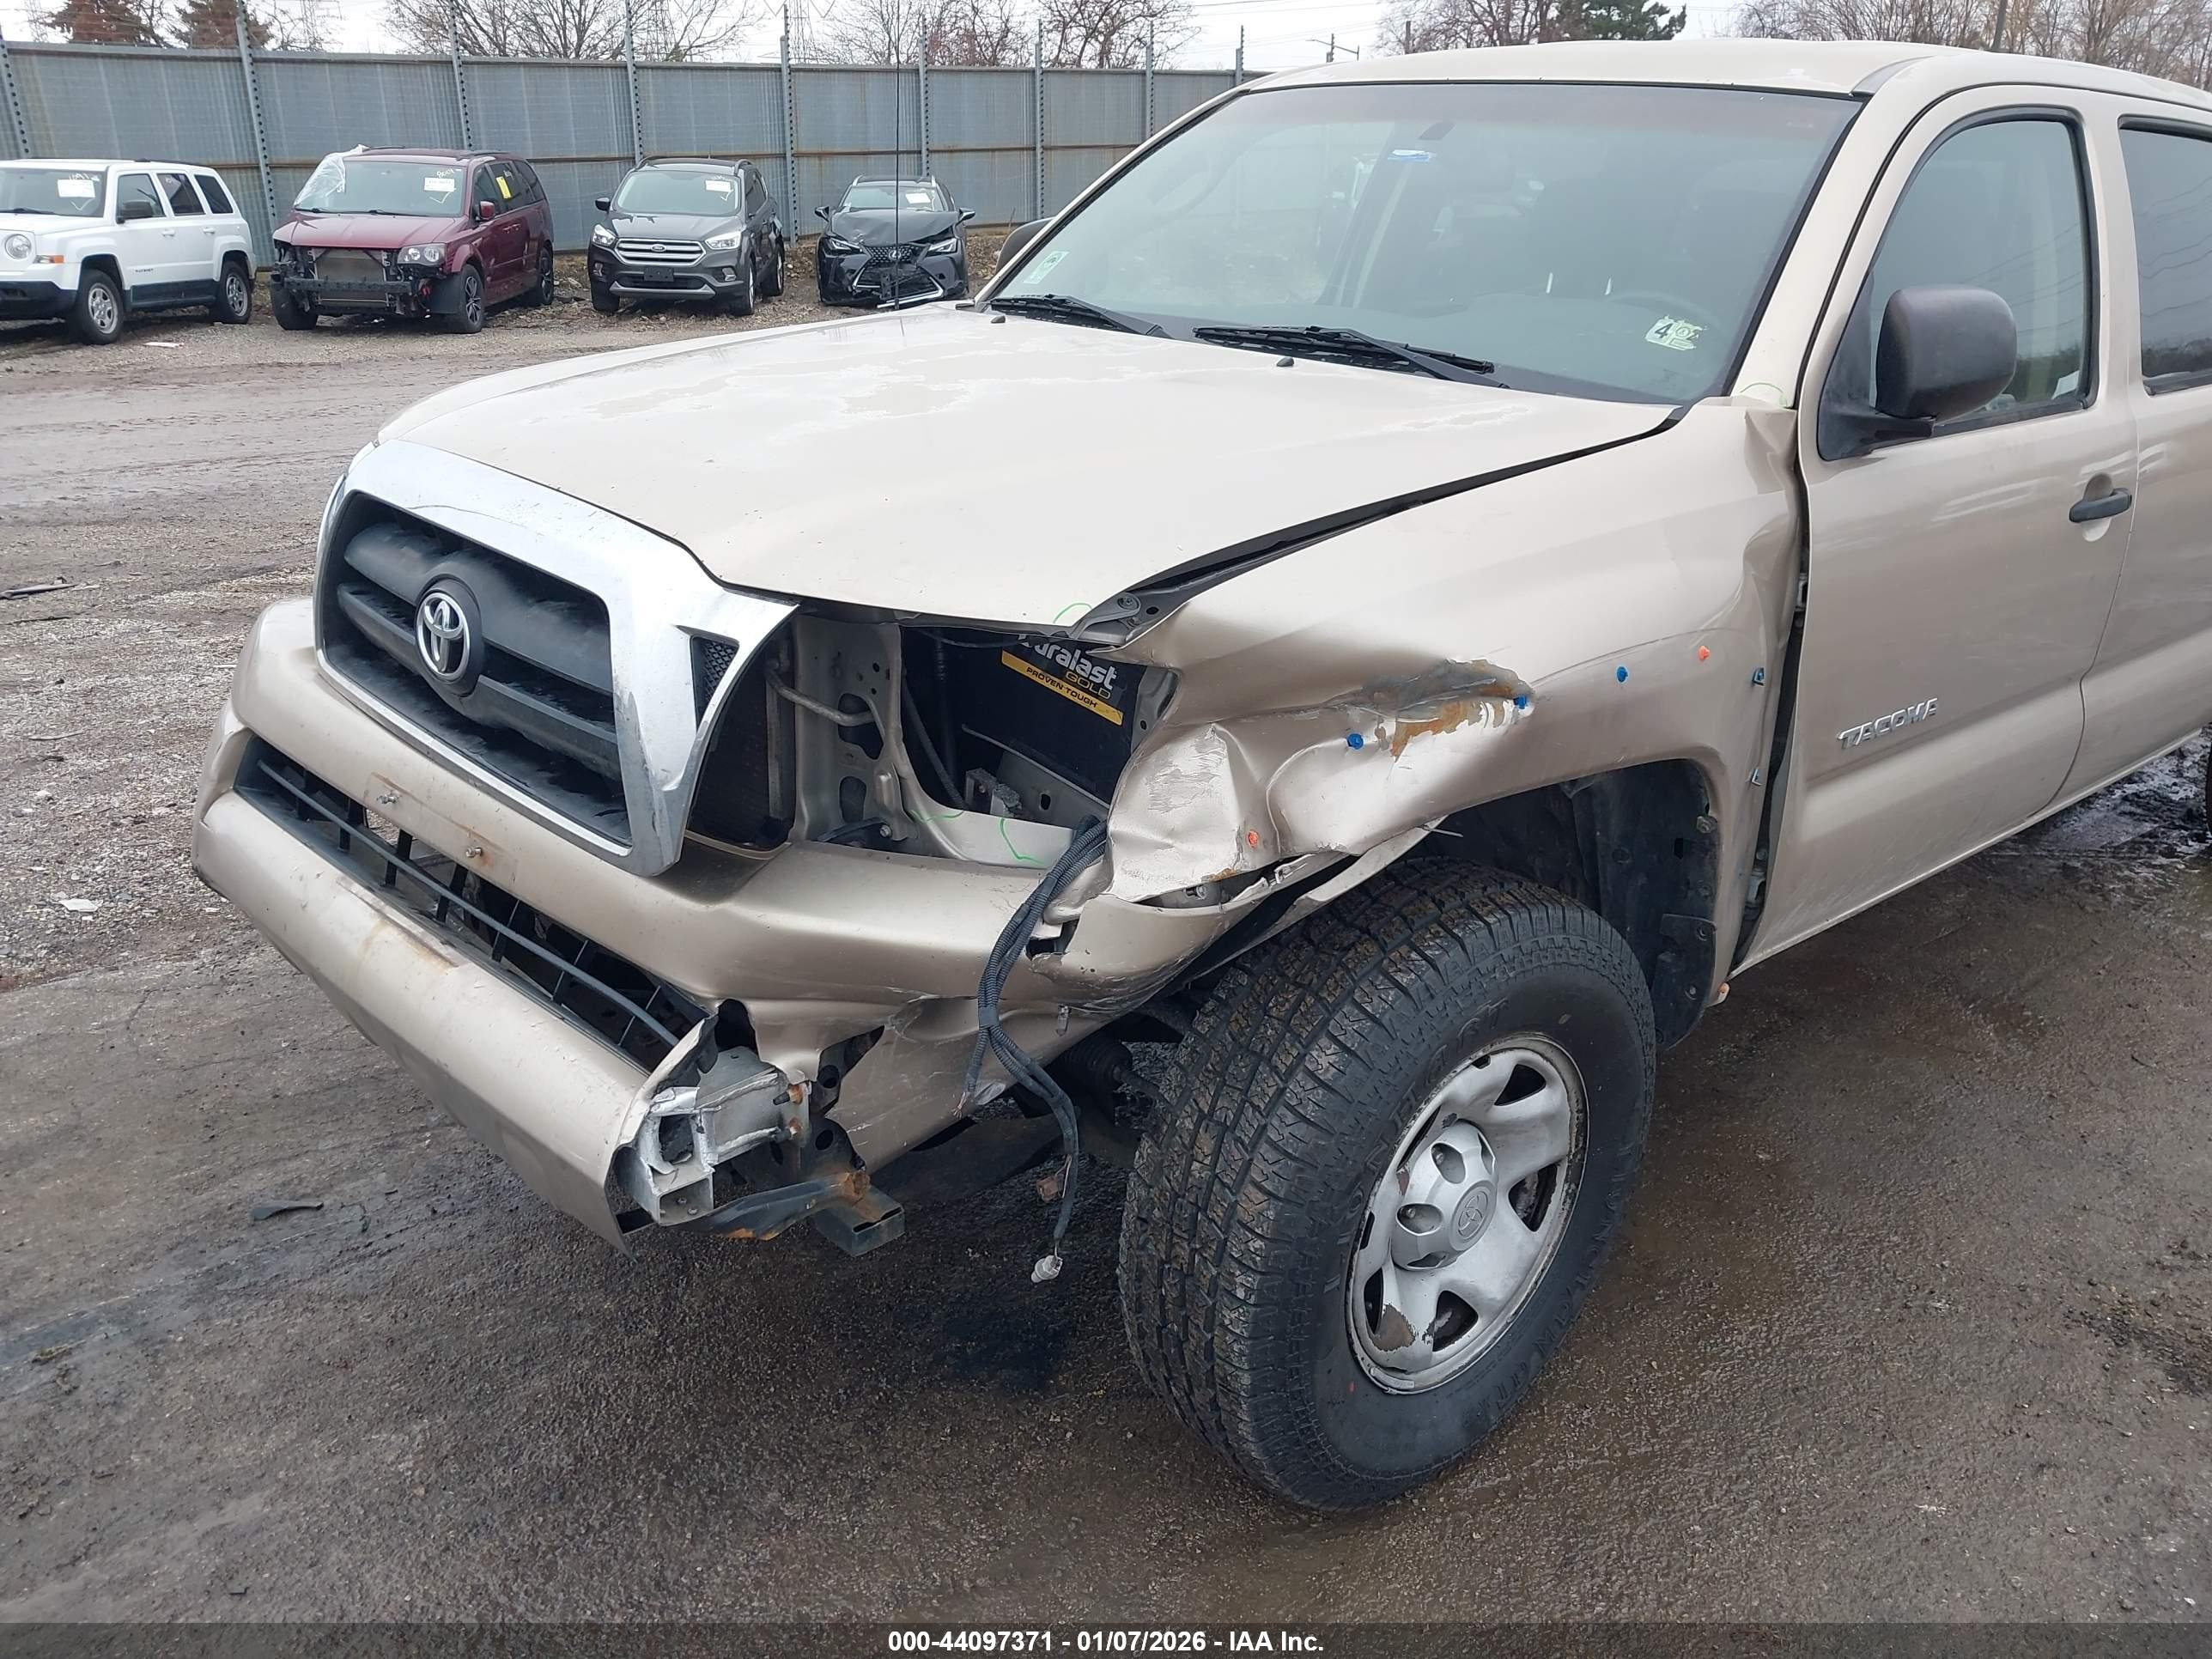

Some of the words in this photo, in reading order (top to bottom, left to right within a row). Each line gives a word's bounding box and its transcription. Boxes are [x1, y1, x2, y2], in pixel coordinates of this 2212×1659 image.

[1654, 322, 1674, 340] 4
[1026, 667, 1064, 690] PROVEN
[1064, 686, 1097, 708] TOUGH
[1066, 671, 1111, 700] GOLD
[1837, 697, 1938, 750] TACOMA
